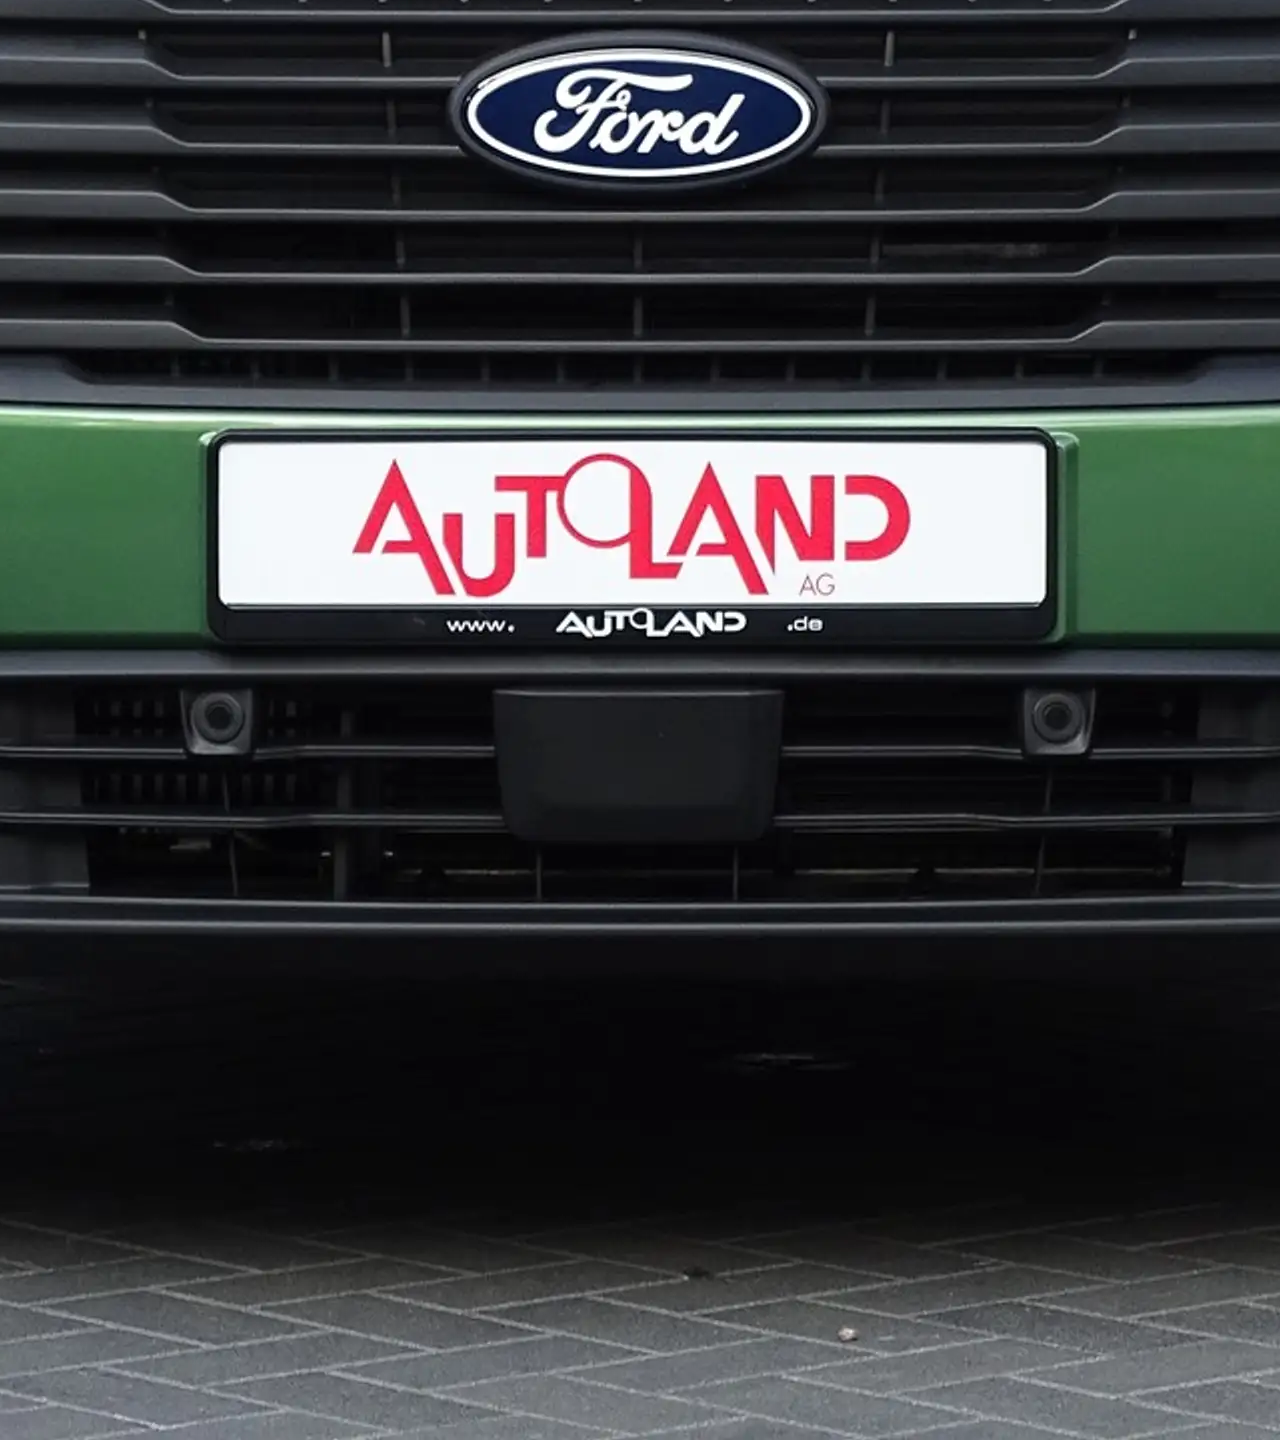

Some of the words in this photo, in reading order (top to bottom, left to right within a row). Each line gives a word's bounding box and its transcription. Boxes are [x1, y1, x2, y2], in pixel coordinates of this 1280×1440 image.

[533, 68, 746, 156] Ford
[353, 453, 911, 598] AUTOLAND
[799, 573, 837, 597] AG
[446, 618, 516, 633] www.
[555, 606, 747, 638] AUTOLAND
[787, 615, 824, 632] .de
